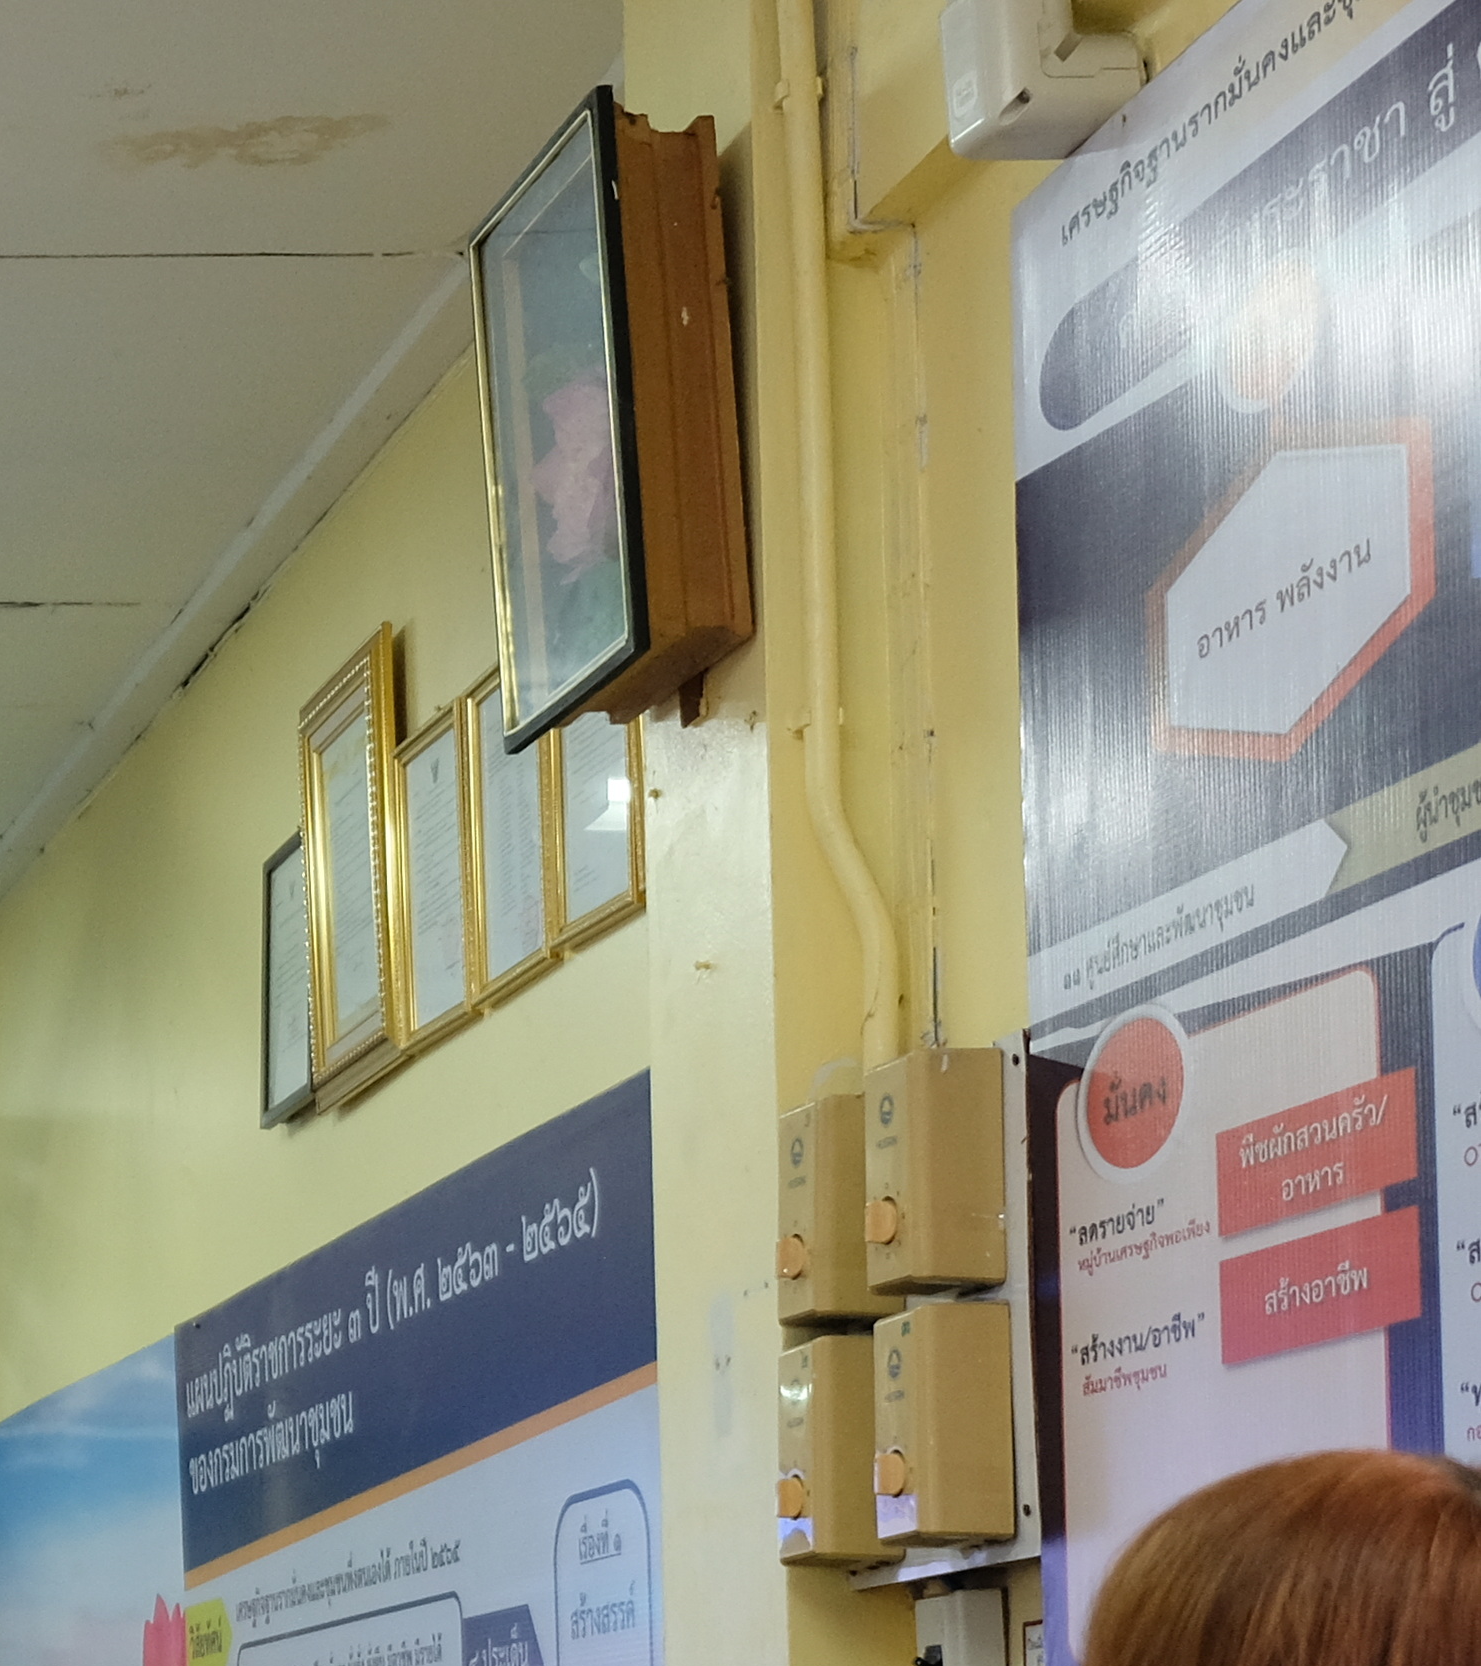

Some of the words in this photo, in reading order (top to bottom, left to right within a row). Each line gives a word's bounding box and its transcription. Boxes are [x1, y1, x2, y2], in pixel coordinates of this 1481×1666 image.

[1428, 42, 1456, 132] สู่
[1196, 599, 1269, 660] อาหาร
[1276, 537, 1373, 613] พลังงาน
[1084, 884, 1256, 990] ศูนย์ศึกษาและพัฒนาชุมชน
[1102, 1069, 1168, 1127] มั่นคง
[1282, 1162, 1345, 1203] อาหาร
[1077, 1217, 1211, 1277] หมู่บ้านเศรษฐกิจพอเพียง
[1264, 1260, 1369, 1315] สร้างอาชีพ
[185, 1307, 342, 1422] แผนปฏิบัติราชการระยะ
[346, 1311, 362, 1344] ๓
[364, 1264, 381, 1334] ปี
[1082, 1363, 1168, 1397] สัมมาชีพชุมชน
[188, 1390, 354, 1496] ของกรมการพัฒนาชุมชน
[578, 1509, 610, 1562] เรื่องที่
[569, 1579, 637, 1641] สร้างสรรค์
